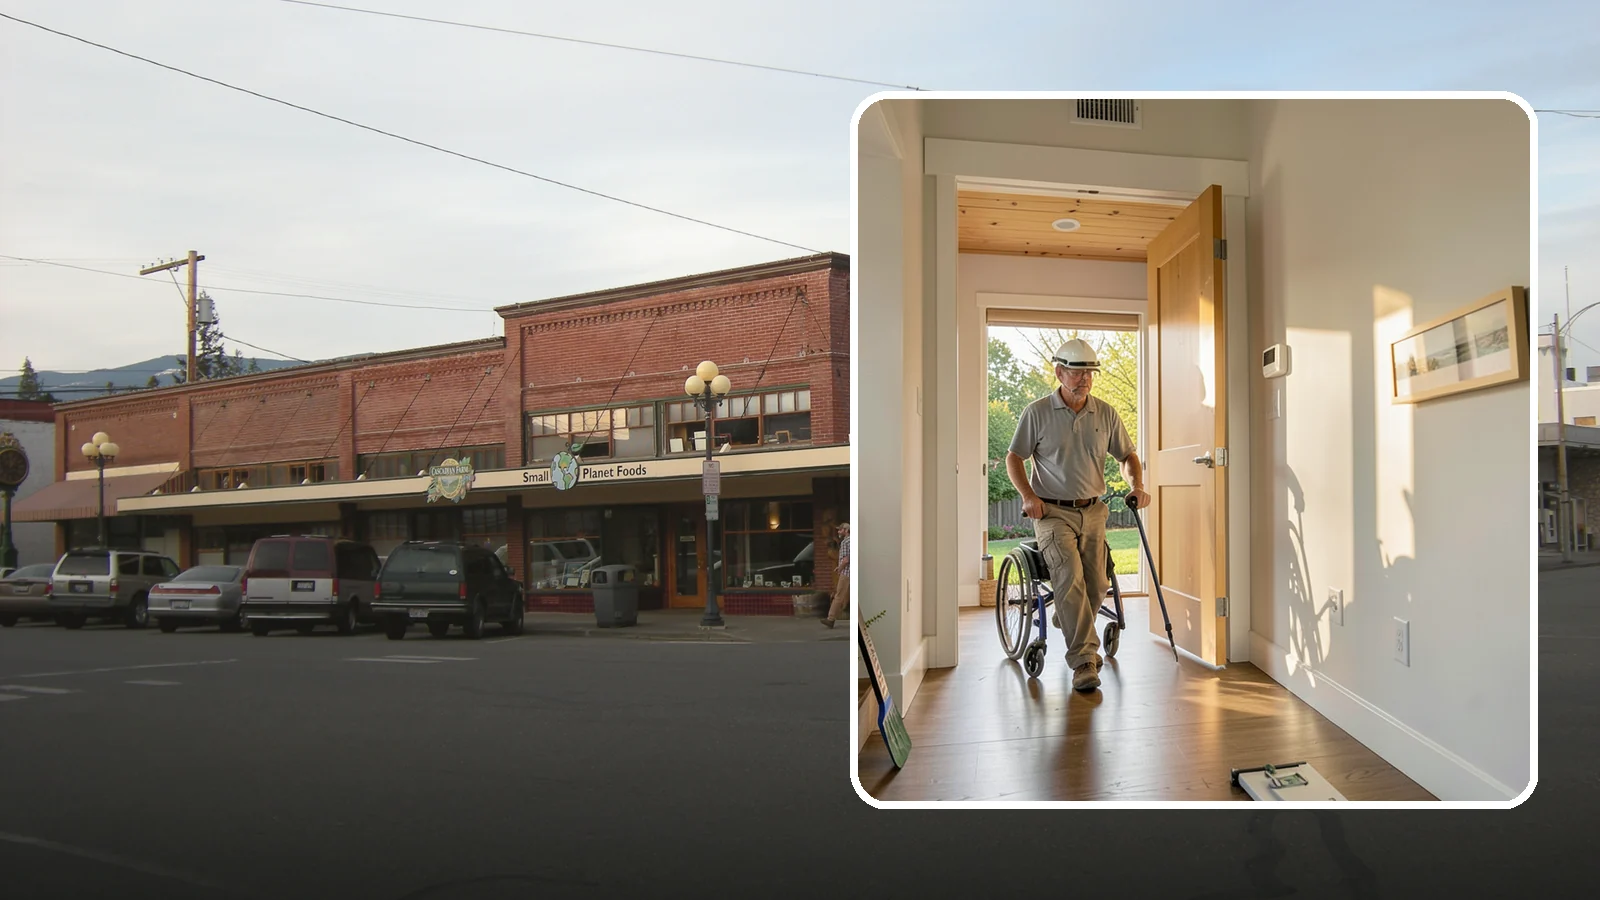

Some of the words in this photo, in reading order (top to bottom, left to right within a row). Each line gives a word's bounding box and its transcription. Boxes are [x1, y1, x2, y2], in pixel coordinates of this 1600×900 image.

[523, 472, 549, 483] Small
[583, 467, 614, 479] Planet
[617, 464, 647, 477] Foods
